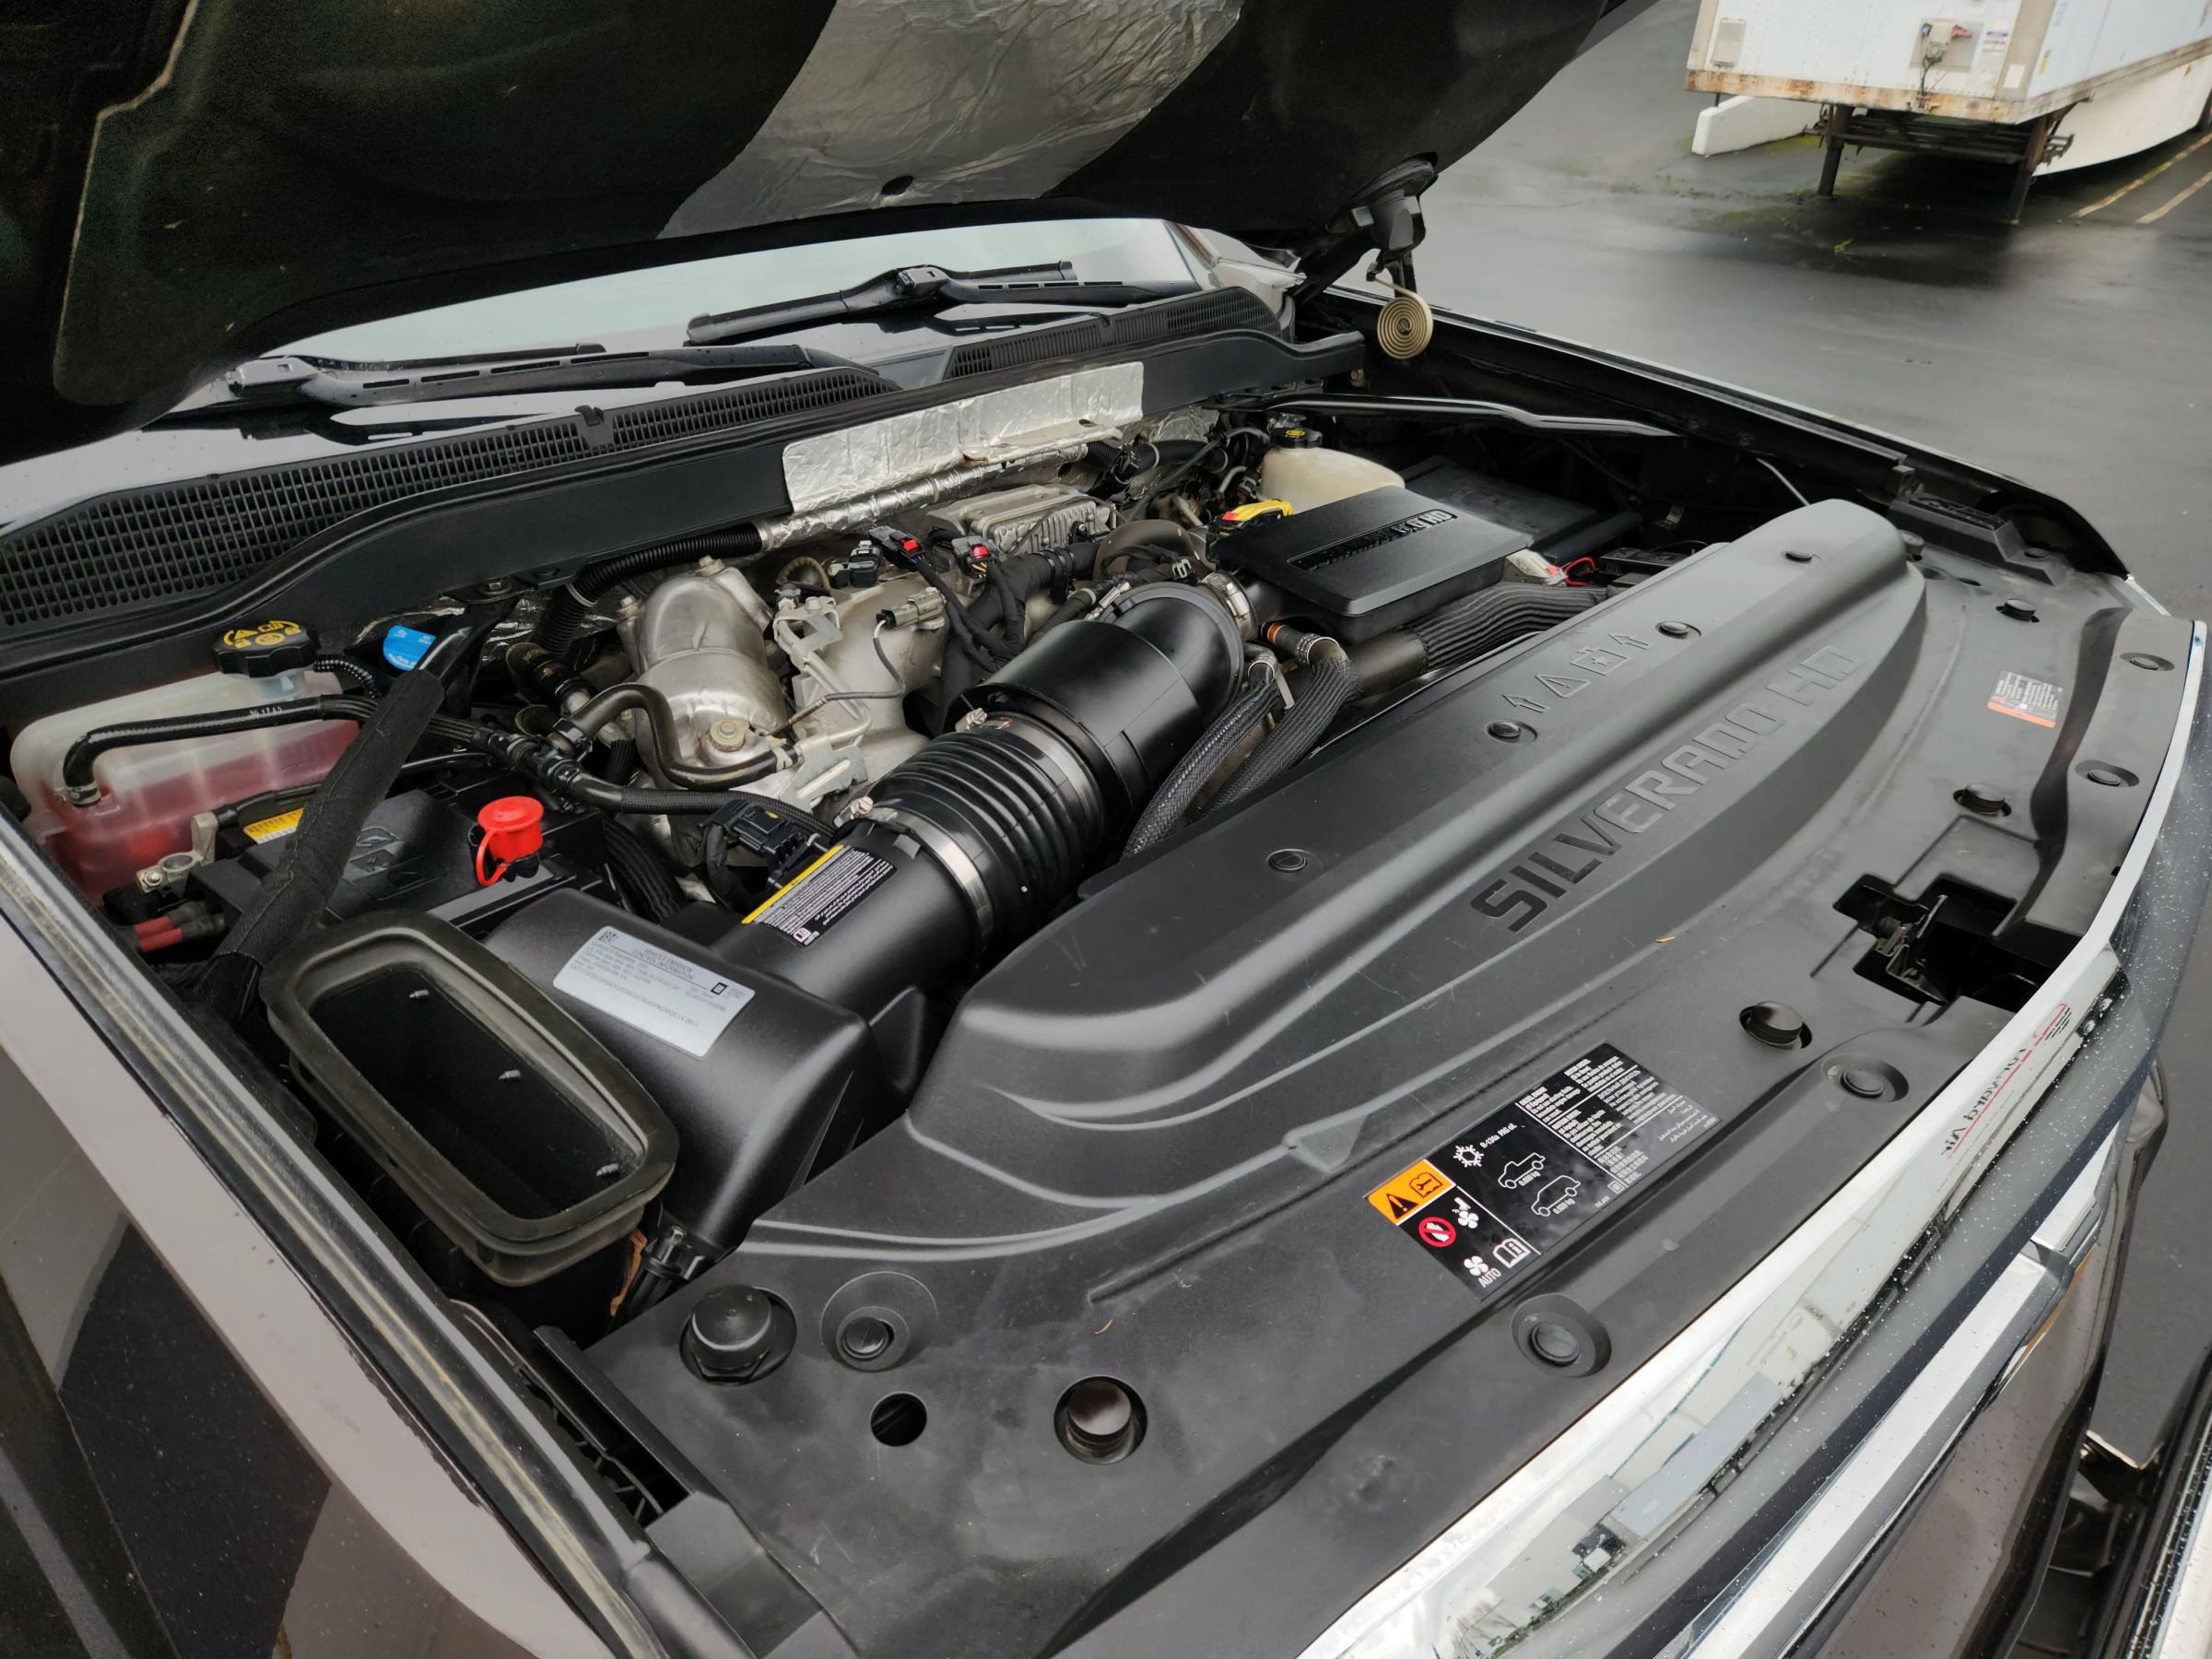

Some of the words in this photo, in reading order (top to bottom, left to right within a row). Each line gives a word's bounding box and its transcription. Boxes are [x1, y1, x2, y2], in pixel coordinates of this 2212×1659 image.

[1422, 510, 1454, 525] HD
[1470, 702, 1786, 933] SILVERADO
[1766, 644, 1866, 706] HD
[1477, 1267, 1501, 1288] AUTO
